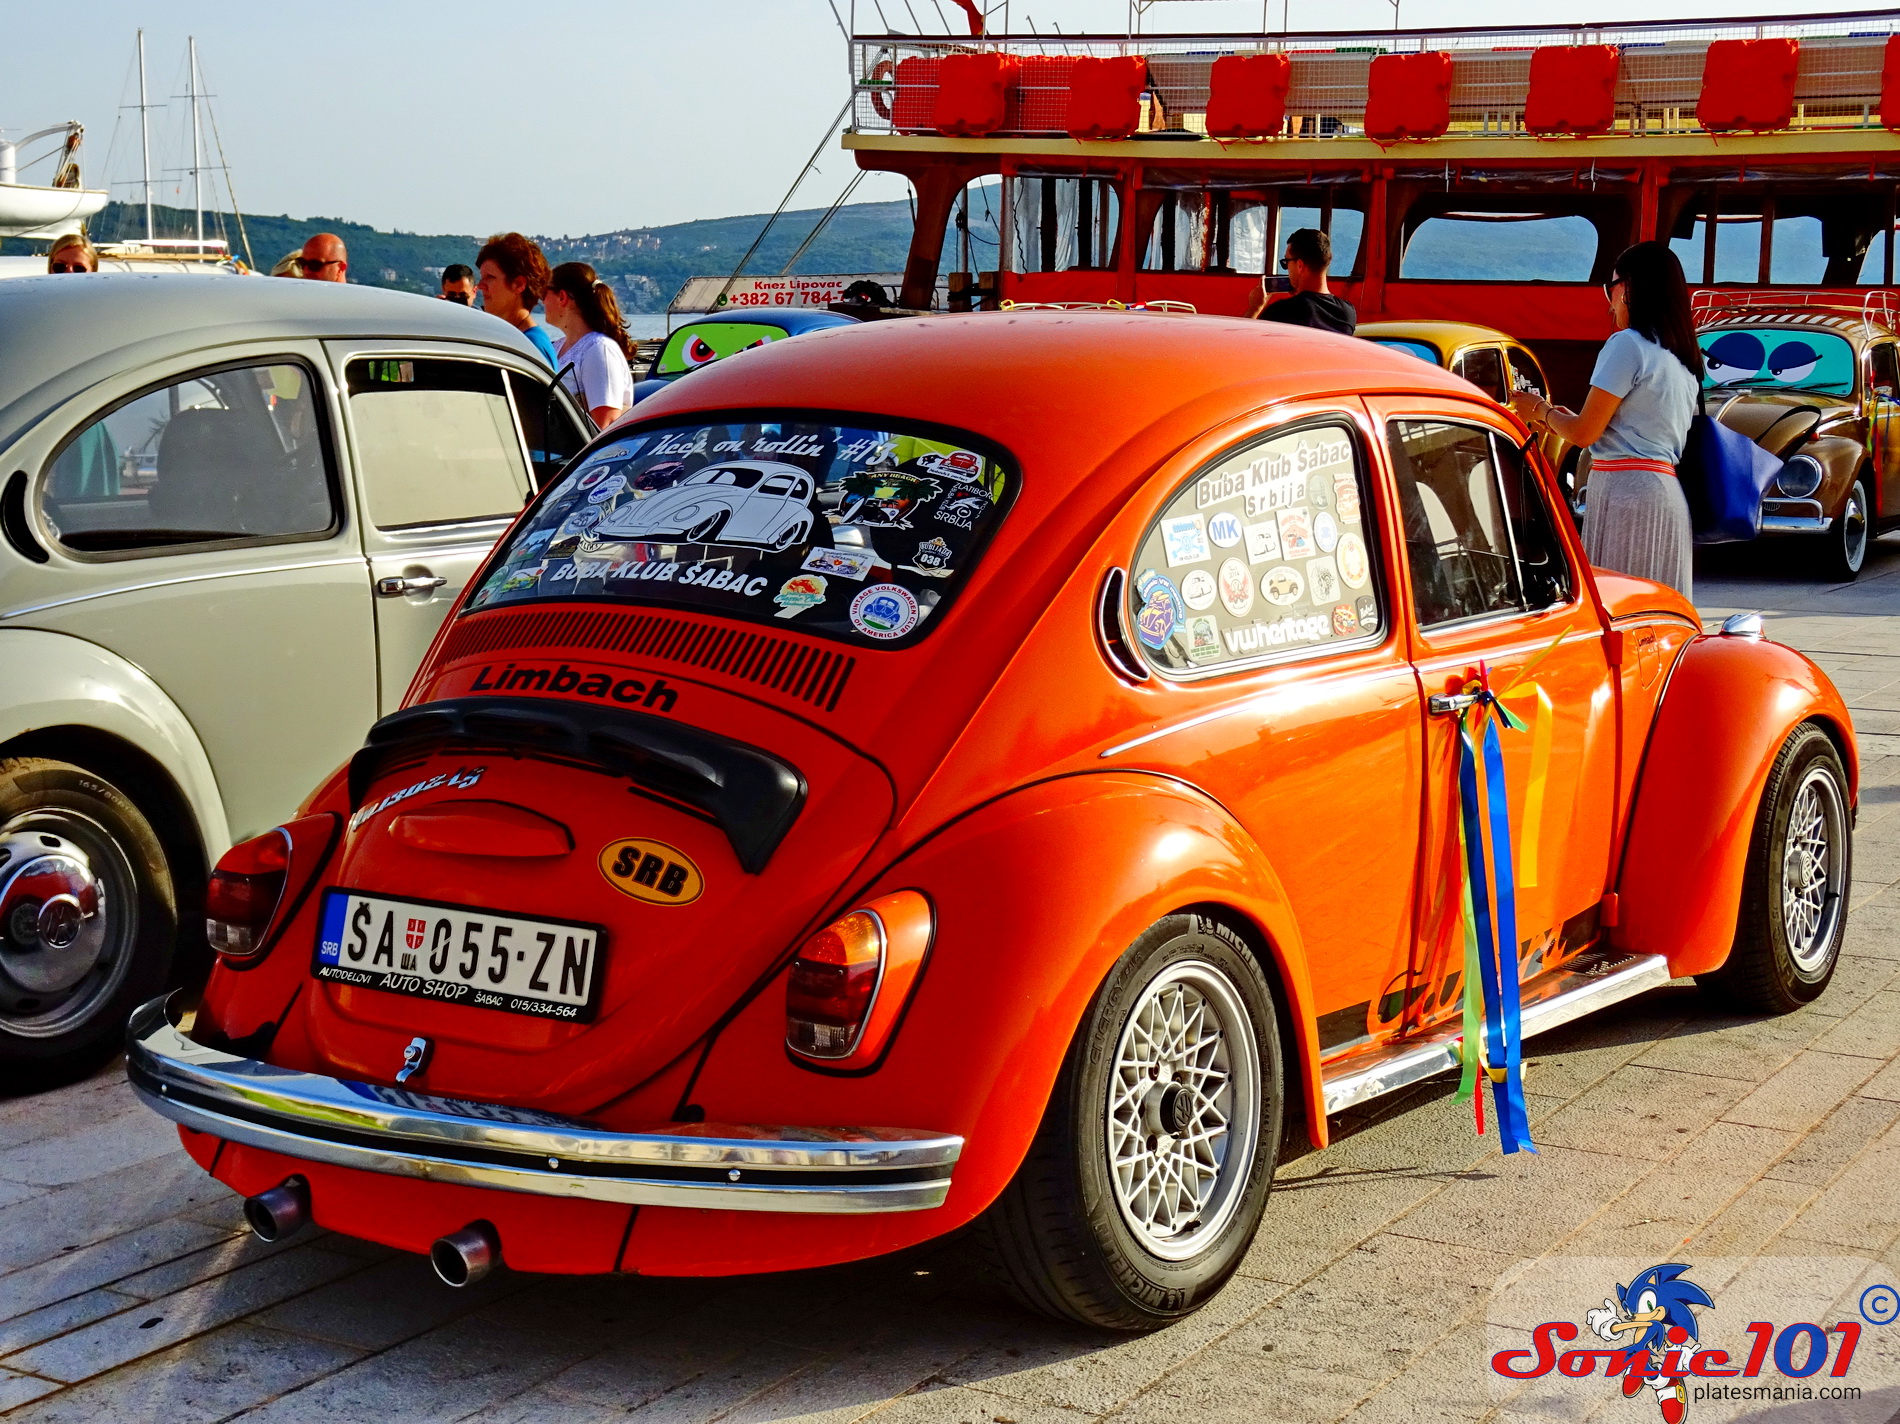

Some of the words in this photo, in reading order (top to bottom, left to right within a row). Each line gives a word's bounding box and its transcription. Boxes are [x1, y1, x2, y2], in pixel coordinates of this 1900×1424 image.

[729, 292, 770, 306] +382
[775, 292, 795, 305] 67
[800, 290, 846, 305] 784-7
[754, 281, 786, 290] Knez
[790, 280, 842, 292] Lipovac
[648, 433, 707, 459] Keep
[713, 440, 746, 453] on
[837, 437, 898, 465] #13
[1199, 472, 1245, 507] Buba
[1251, 456, 1292, 488] Klub
[1297, 440, 1351, 471] Šabac
[952, 482, 993, 501] ZLATIBOR
[934, 510, 972, 531] SRBIJA
[1211, 519, 1239, 541] MK
[920, 553, 941, 567] 038
[550, 561, 613, 582] BUBA
[611, 561, 681, 581] KLUB
[678, 562, 768, 596] ŠABAC
[852, 589, 873, 615] VINTAGE
[875, 585, 917, 615] VOLKSWAGEN
[900, 616, 916, 634] CLUB
[853, 618, 863, 628] OF
[861, 626, 899, 638] AMERICA
[469, 664, 679, 713] Limbach
[611, 845, 689, 898] SRB
[347, 901, 395, 968] ŠA
[320, 940, 339, 957] SRB
[318, 966, 373, 984] AUTODELOVI
[379, 973, 421, 992] AUTO
[422, 980, 468, 1000] SHOP
[474, 990, 503, 1006] ŠABAC
[510, 998, 578, 1018] 015/334-564
